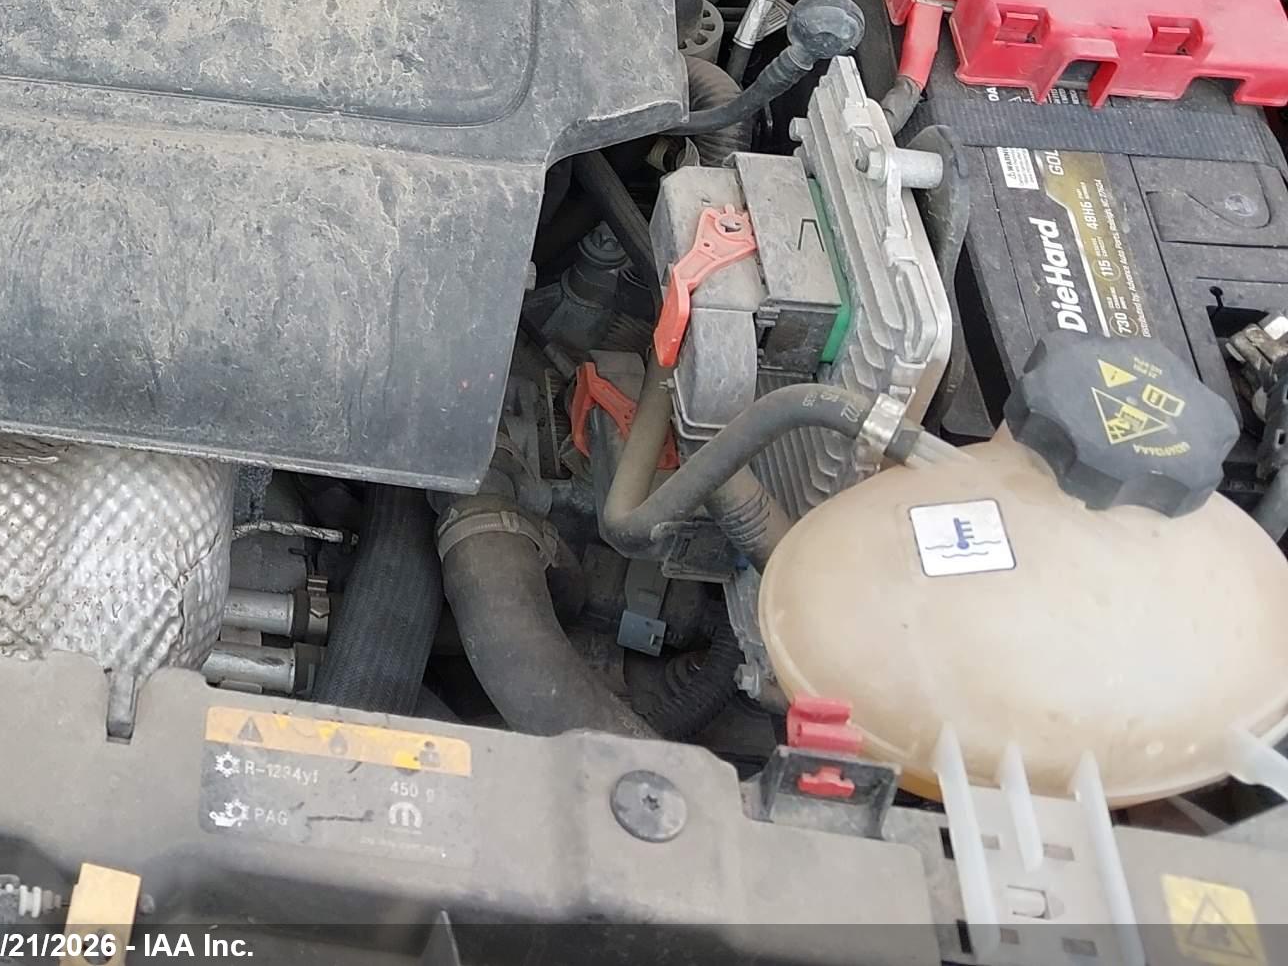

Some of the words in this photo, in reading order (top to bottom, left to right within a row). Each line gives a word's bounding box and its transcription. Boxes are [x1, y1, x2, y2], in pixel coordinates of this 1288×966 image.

[1044, 149, 1065, 176] GOL
[1028, 216, 1089, 334] DieHard
[1097, 259, 1114, 277] 115
[1114, 312, 1133, 334] 730
[244, 761, 319, 785] R-1234yf
[389, 781, 418, 797] 450
[254, 808, 289, 826] PAG
